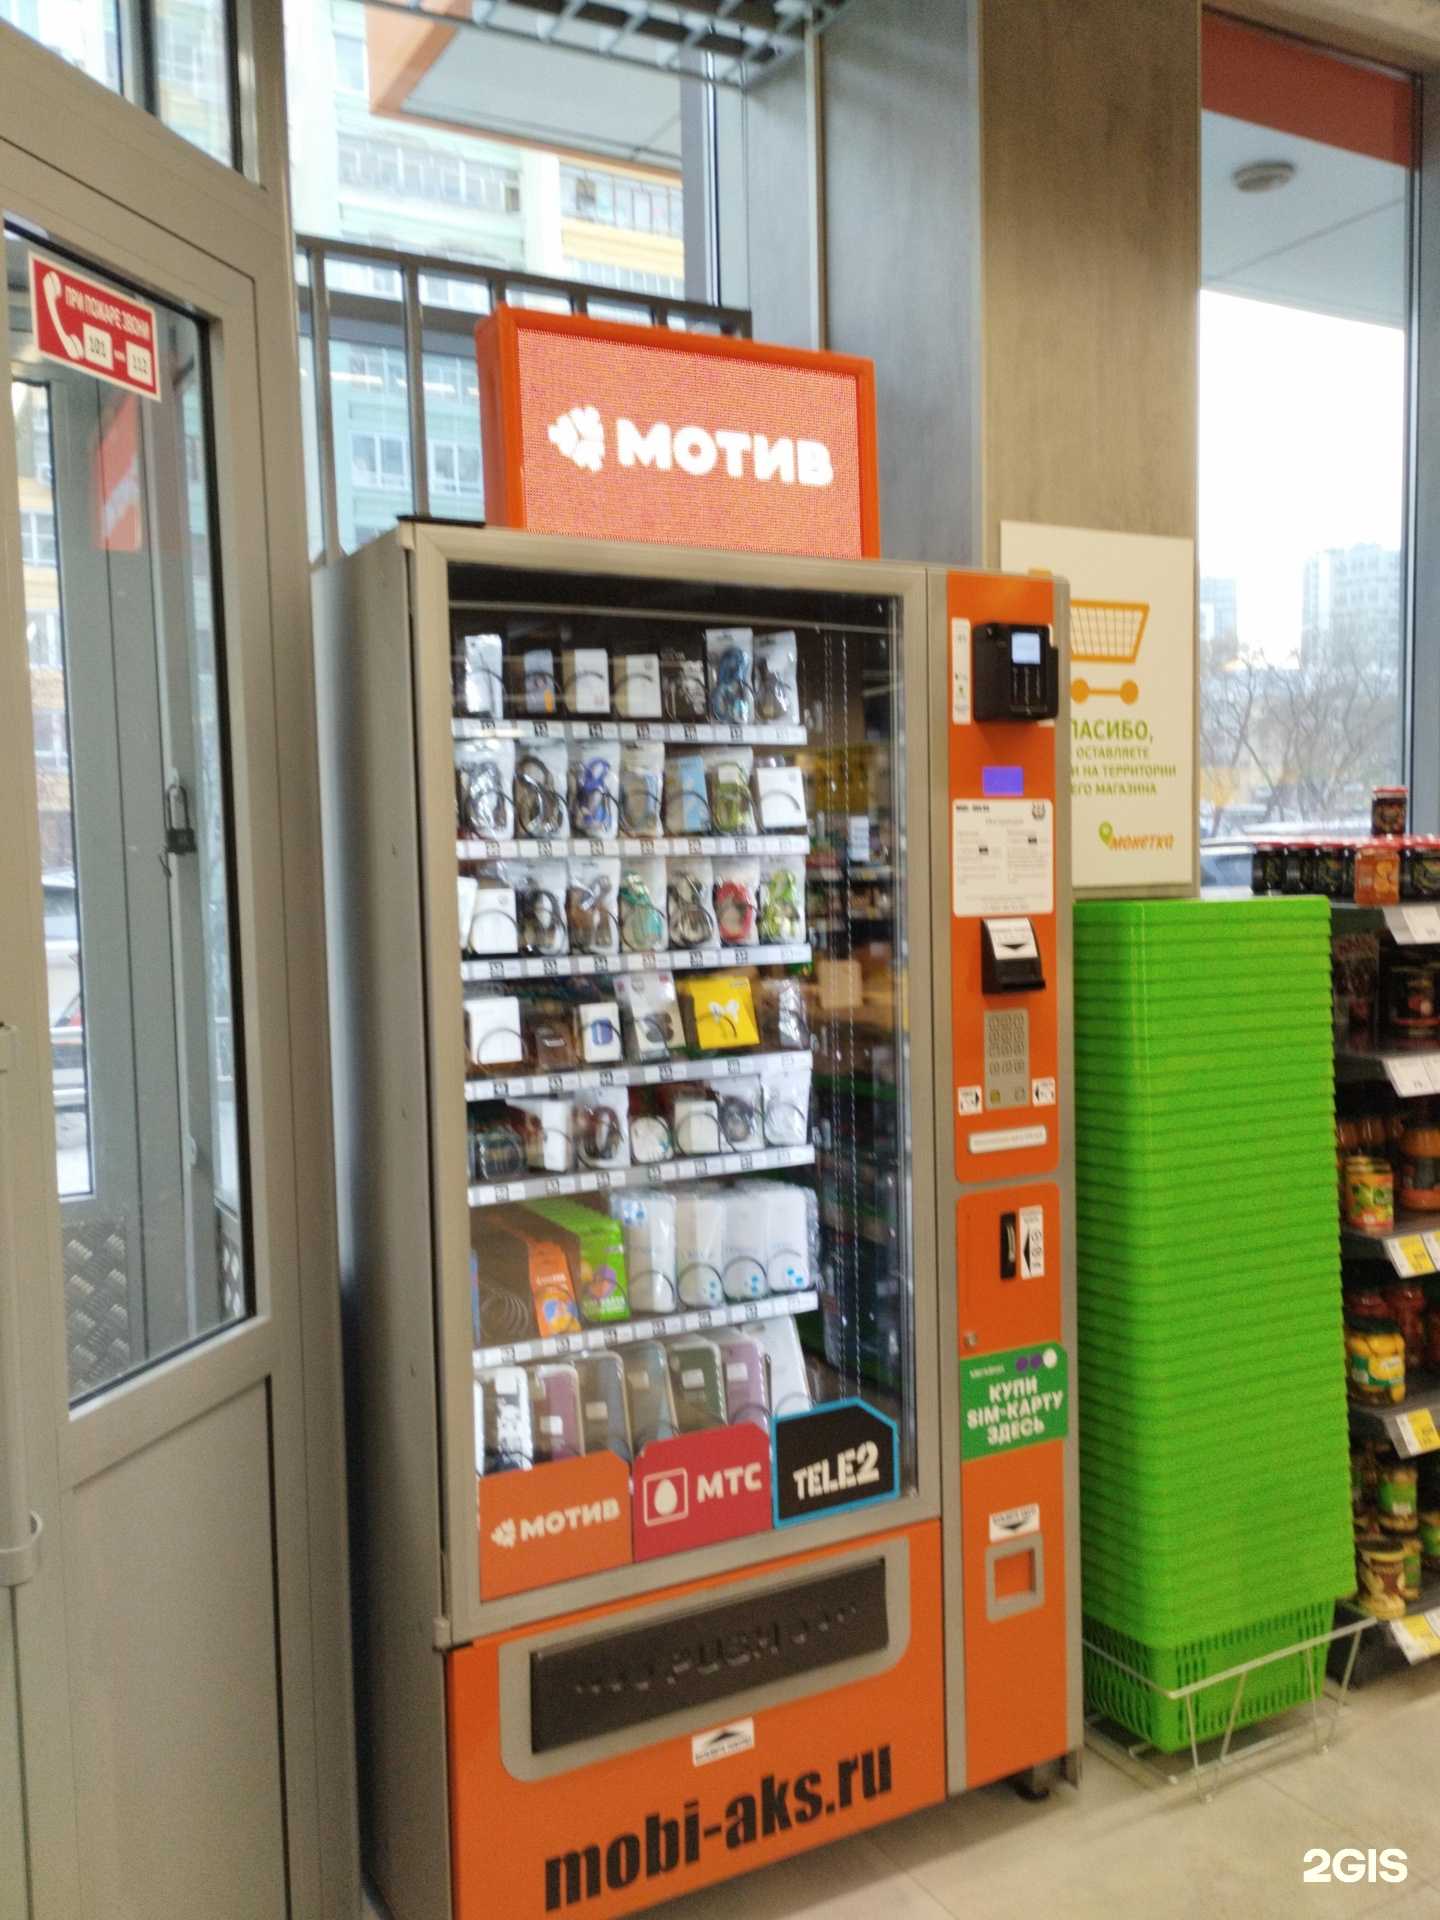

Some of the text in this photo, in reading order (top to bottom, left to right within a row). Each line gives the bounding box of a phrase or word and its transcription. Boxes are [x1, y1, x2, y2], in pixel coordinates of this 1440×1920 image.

[616, 417, 834, 486] МОТИВ
[1071, 719, 1153, 744] ПАСИБО,
[1083, 764, 1098, 778] НА
[1103, 764, 1176, 778] ТЕРРИТОРИИ
[1095, 783, 1157, 797] МАГАЗИНА
[989, 1375, 1038, 1404] КУПИ
[987, 1415, 1045, 1446] ЗДЕСЬ
[696, 1462, 762, 1504] МТС
[793, 1440, 881, 1499] TELE2
[520, 1497, 620, 1541] МОТИВ
[545, 1744, 892, 1912] mobi-aks.ru
